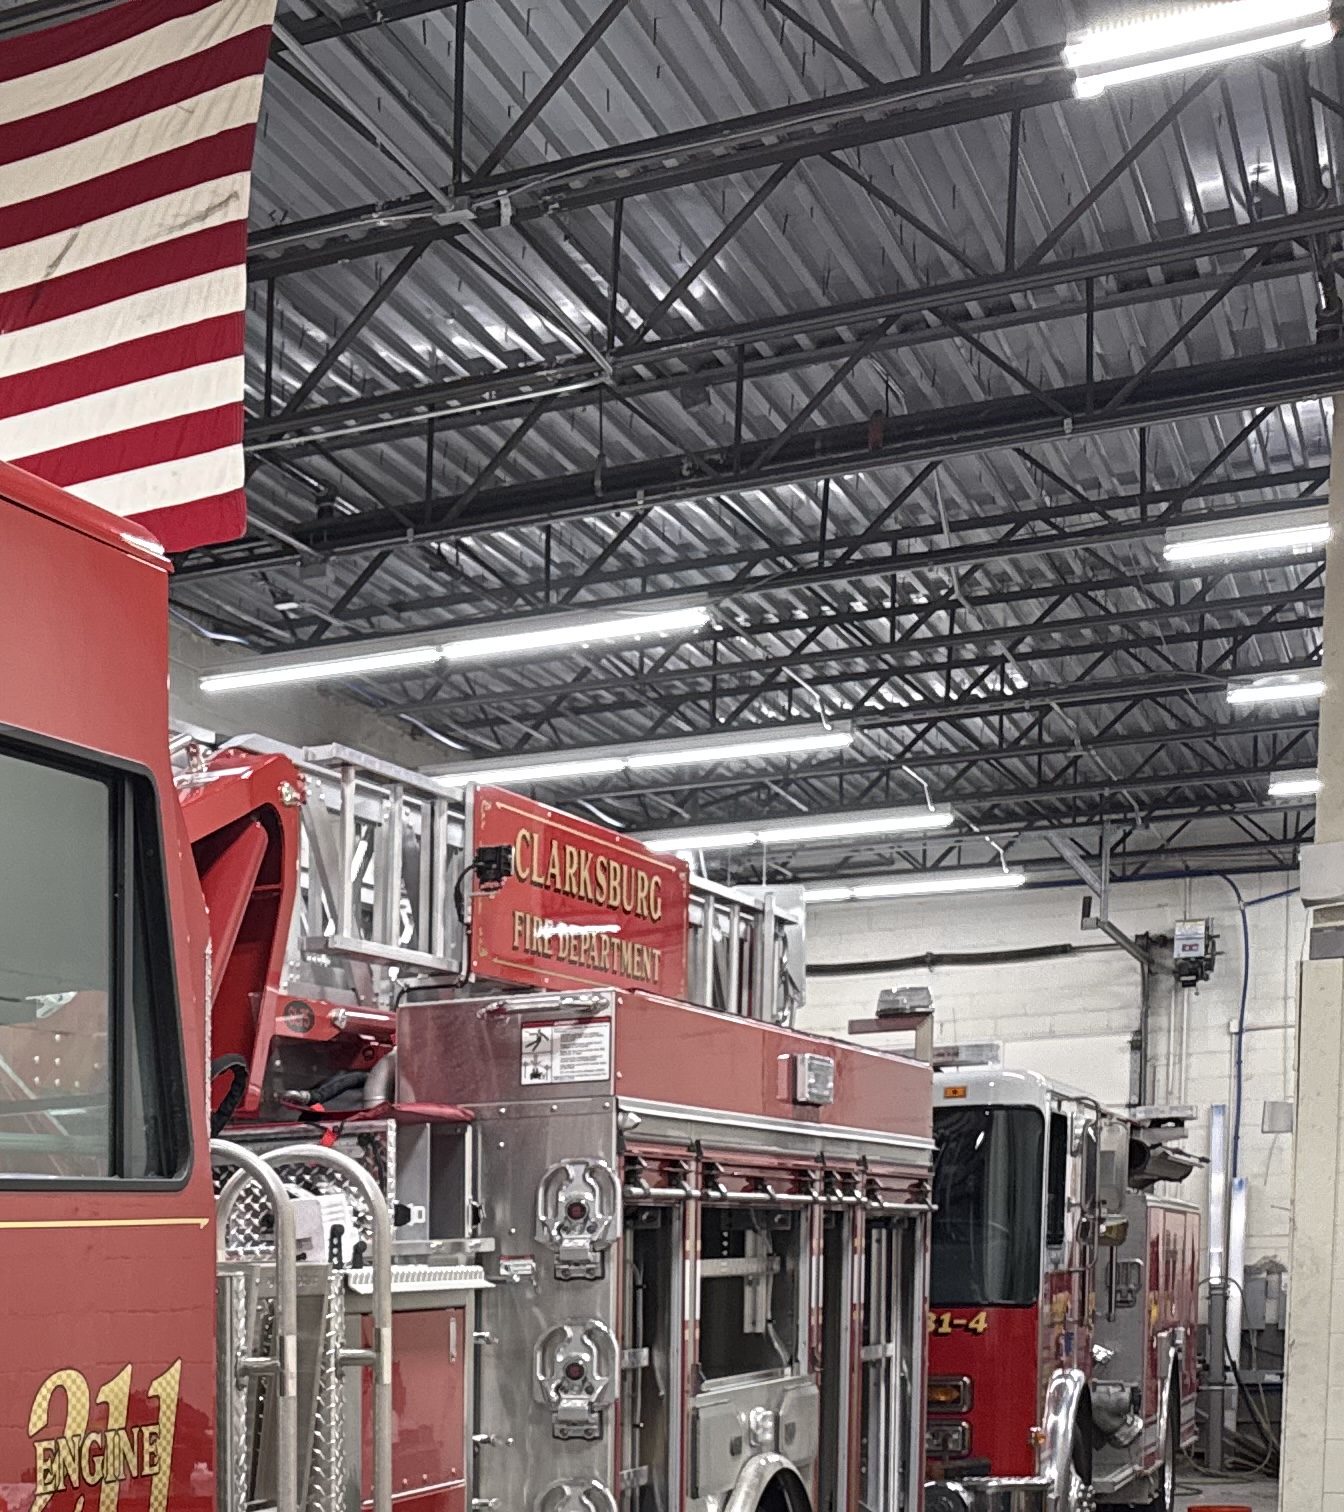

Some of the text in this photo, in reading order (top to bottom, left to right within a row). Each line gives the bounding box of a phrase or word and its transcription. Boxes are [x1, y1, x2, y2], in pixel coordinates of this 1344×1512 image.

[514, 828, 662, 924] CLARKSBURG
[513, 910, 662, 984] FIRE DEPARTMENT
[33, 1423, 162, 1496] ENGINE
